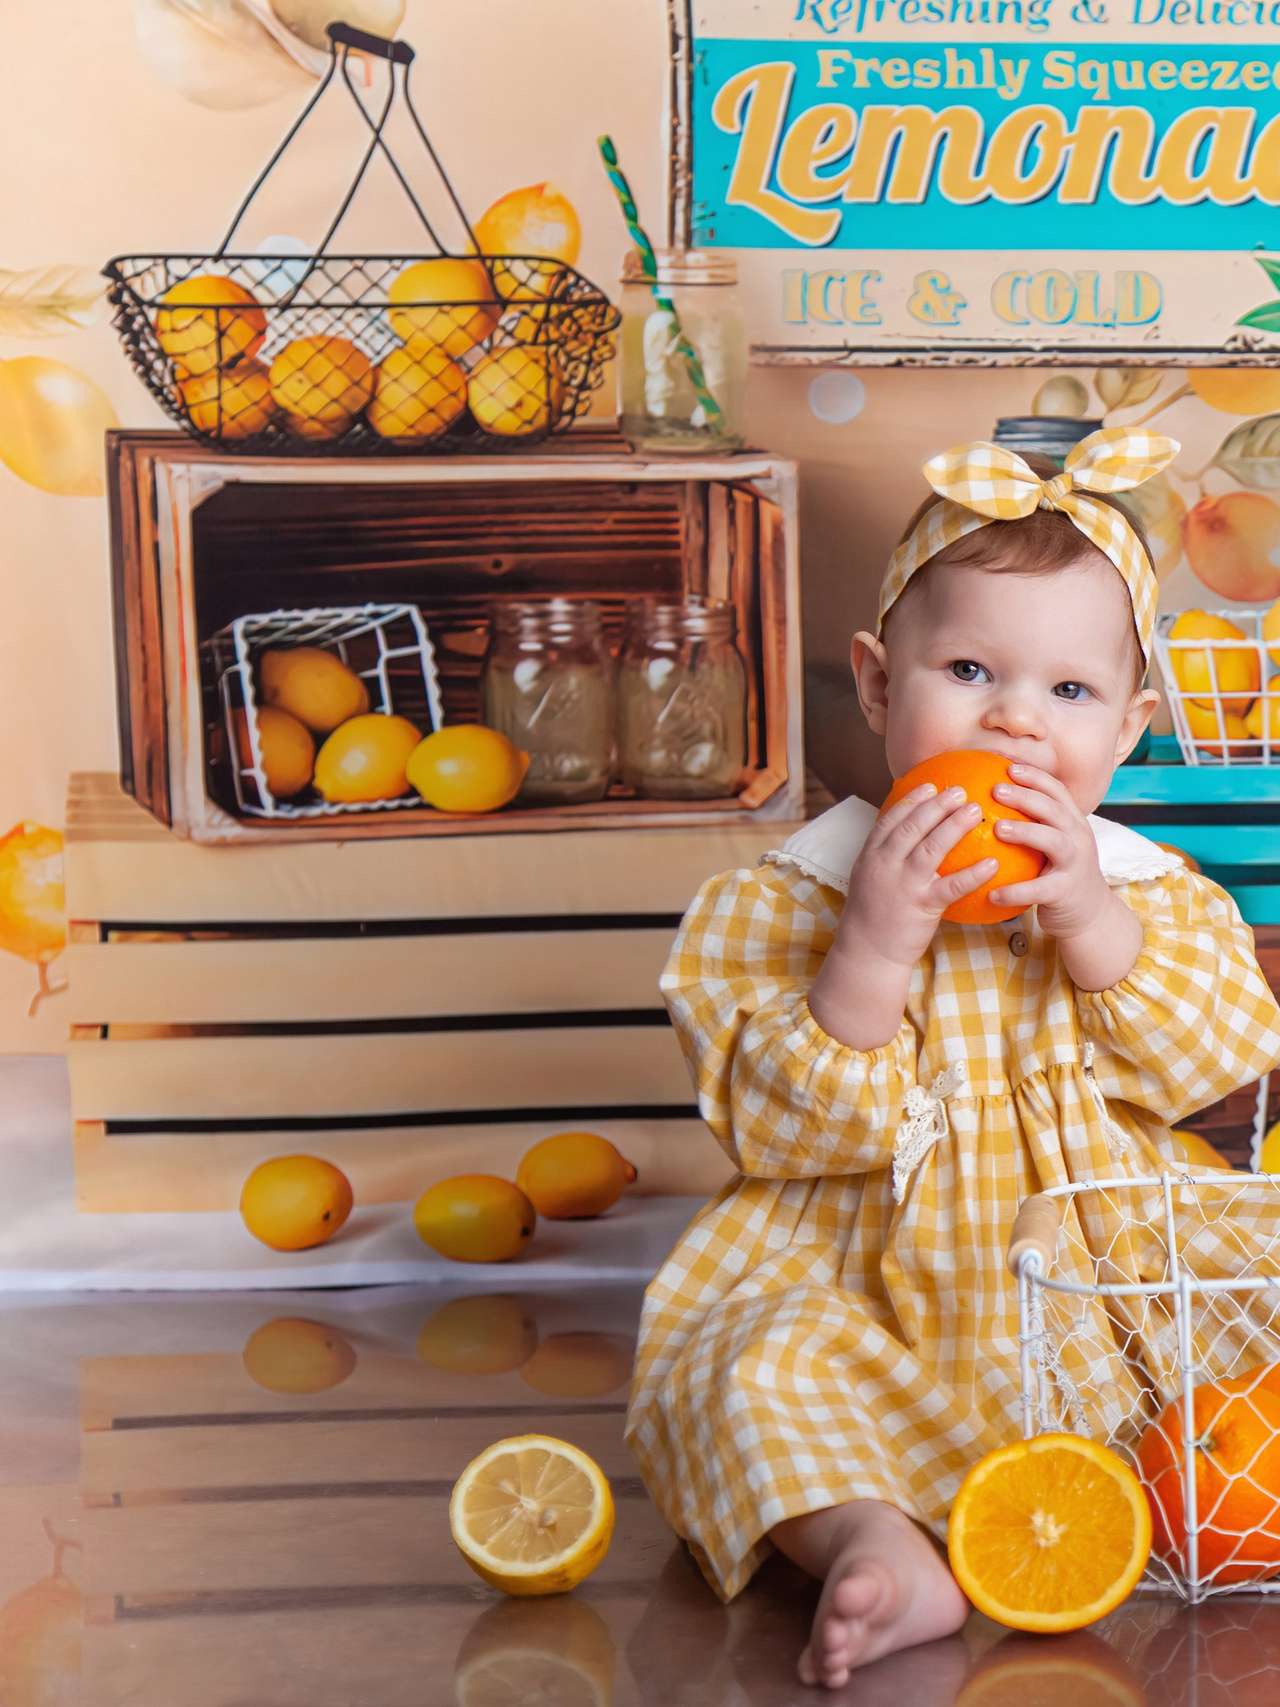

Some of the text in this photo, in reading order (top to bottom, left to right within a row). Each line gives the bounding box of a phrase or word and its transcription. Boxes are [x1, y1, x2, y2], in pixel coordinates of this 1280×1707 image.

[1071, 0, 1108, 24] &
[816, 48, 1031, 100] Freshly
[781, 268, 1163, 328] ICE & COLD
